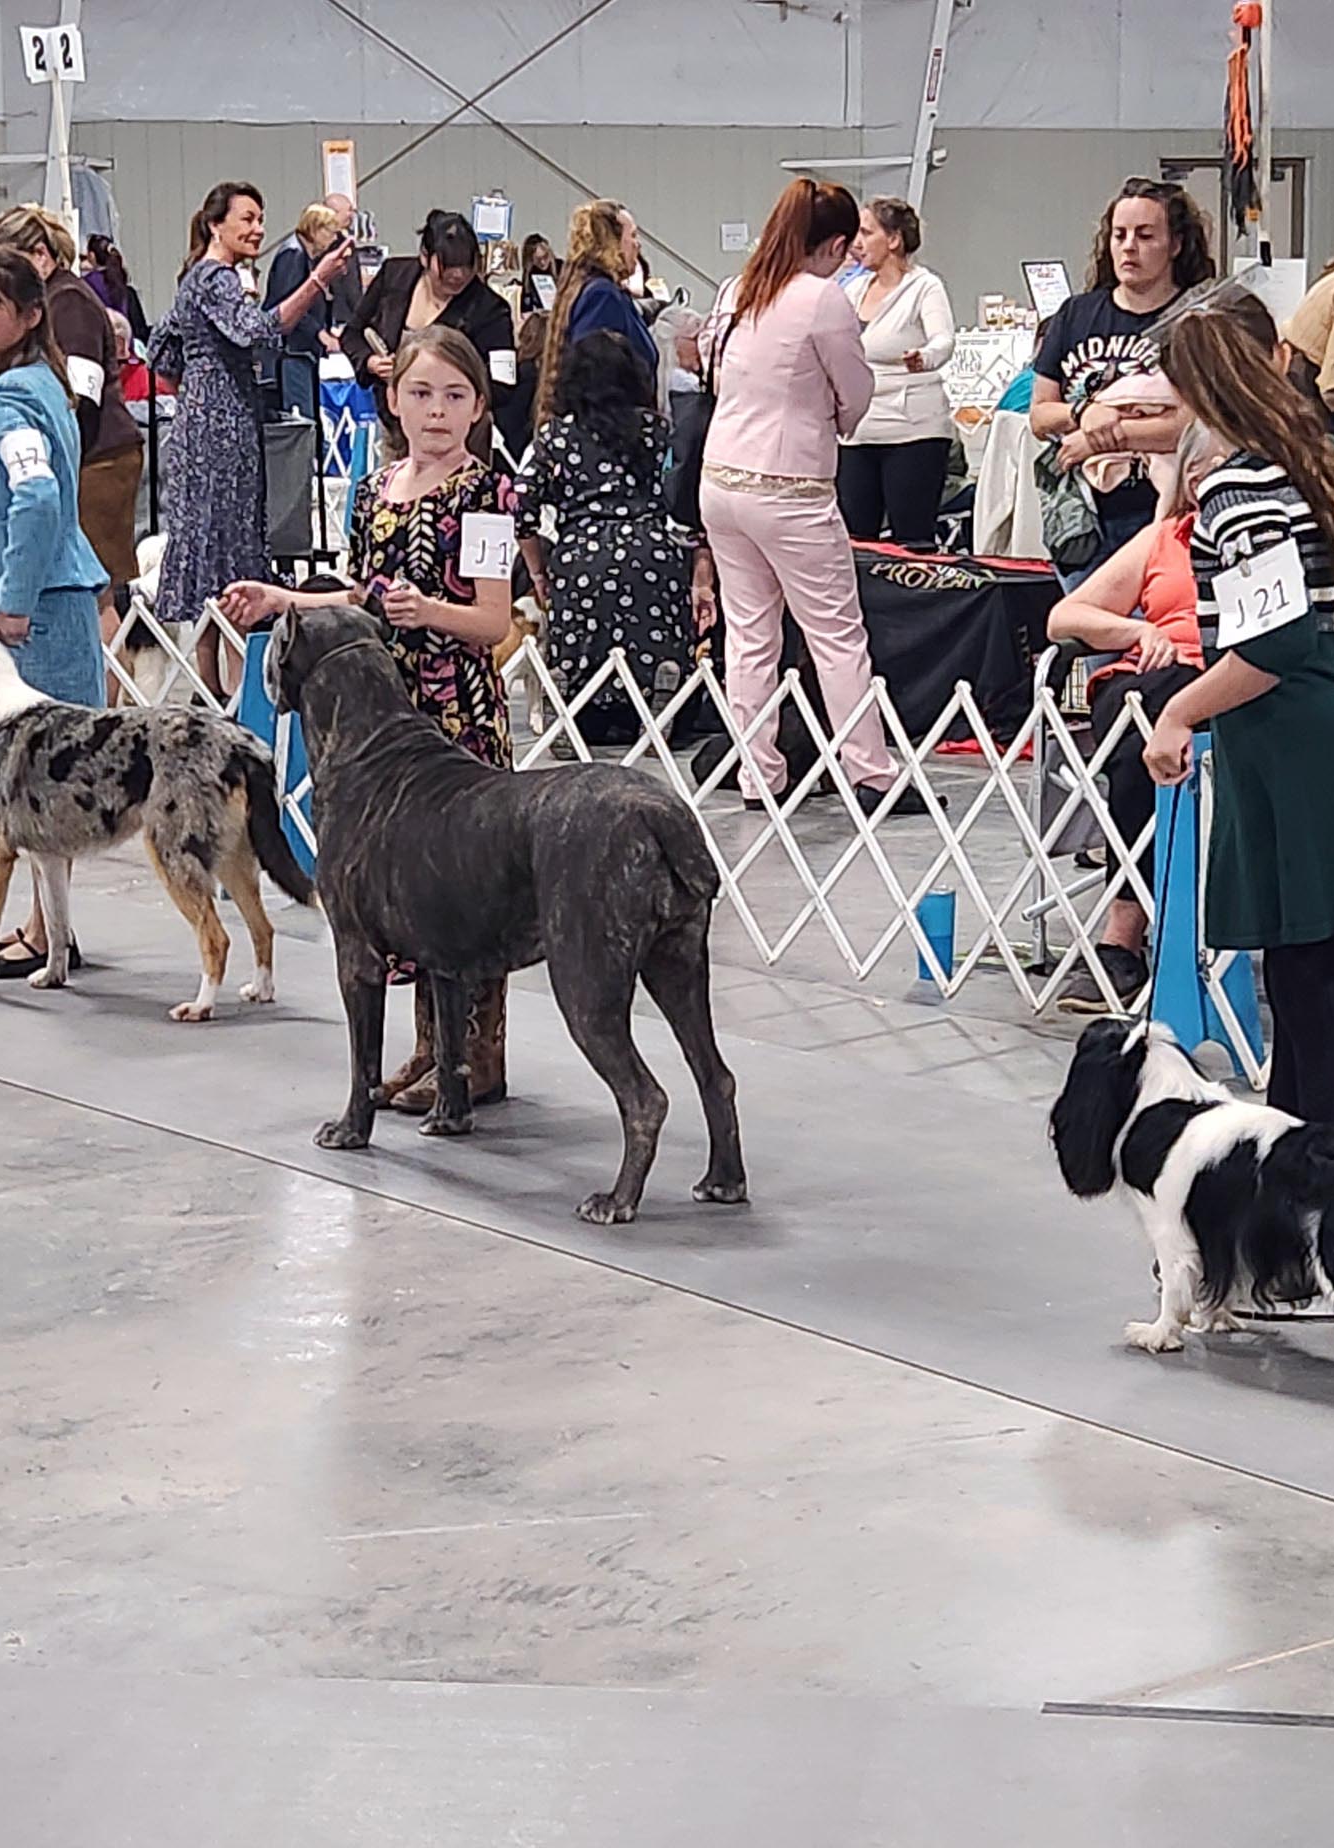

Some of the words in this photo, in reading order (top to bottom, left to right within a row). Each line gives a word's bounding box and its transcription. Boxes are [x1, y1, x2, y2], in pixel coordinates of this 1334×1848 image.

[32, 34, 47, 72] 2
[59, 32, 73, 69] 2
[1060, 334, 1162, 378] MIDNIGH
[475, 539, 486, 565] J
[1235, 598, 1246, 629] J
[1253, 578, 1291, 620] 21
